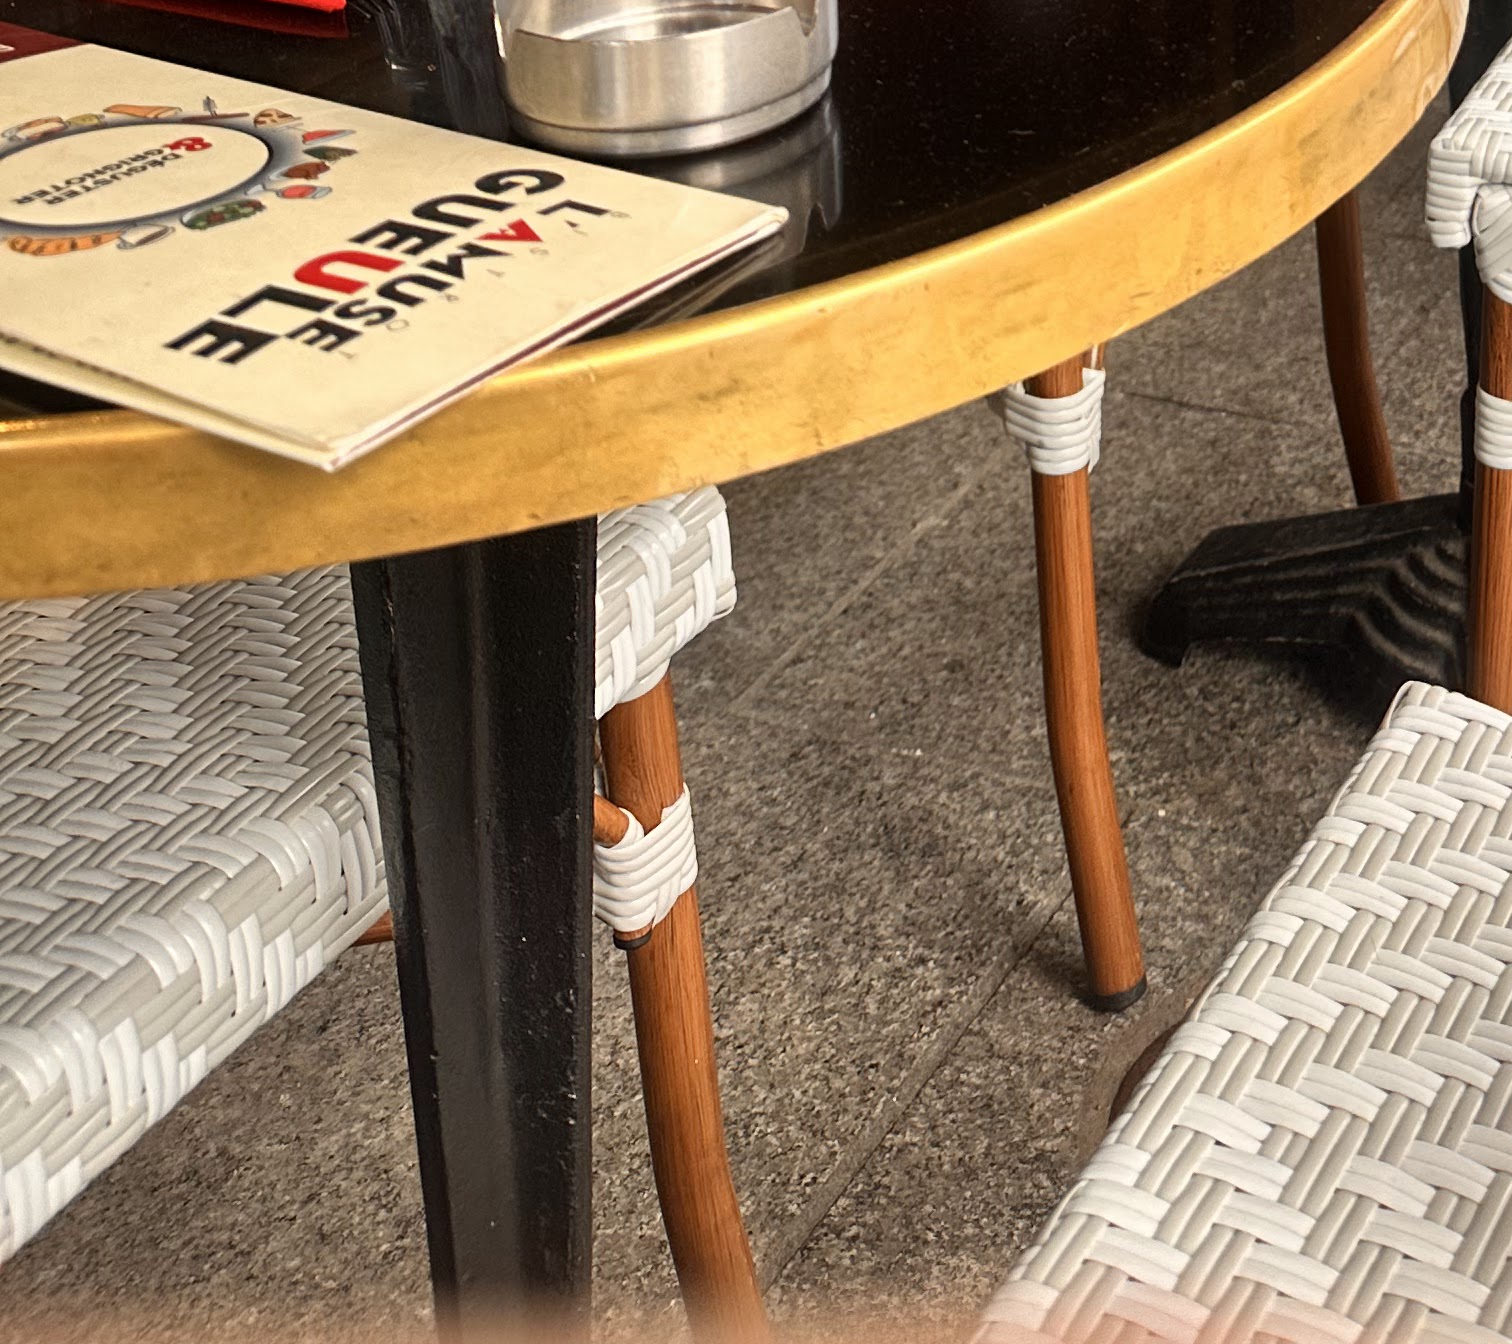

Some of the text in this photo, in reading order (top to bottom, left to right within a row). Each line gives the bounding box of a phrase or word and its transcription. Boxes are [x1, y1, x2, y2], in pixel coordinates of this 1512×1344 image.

[14, 147, 165, 205] GRIGNOTER
[46, 152, 183, 205] DÉGUSTER
[163, 168, 566, 366] GUEULE
[283, 198, 614, 354] L'AMUSE
